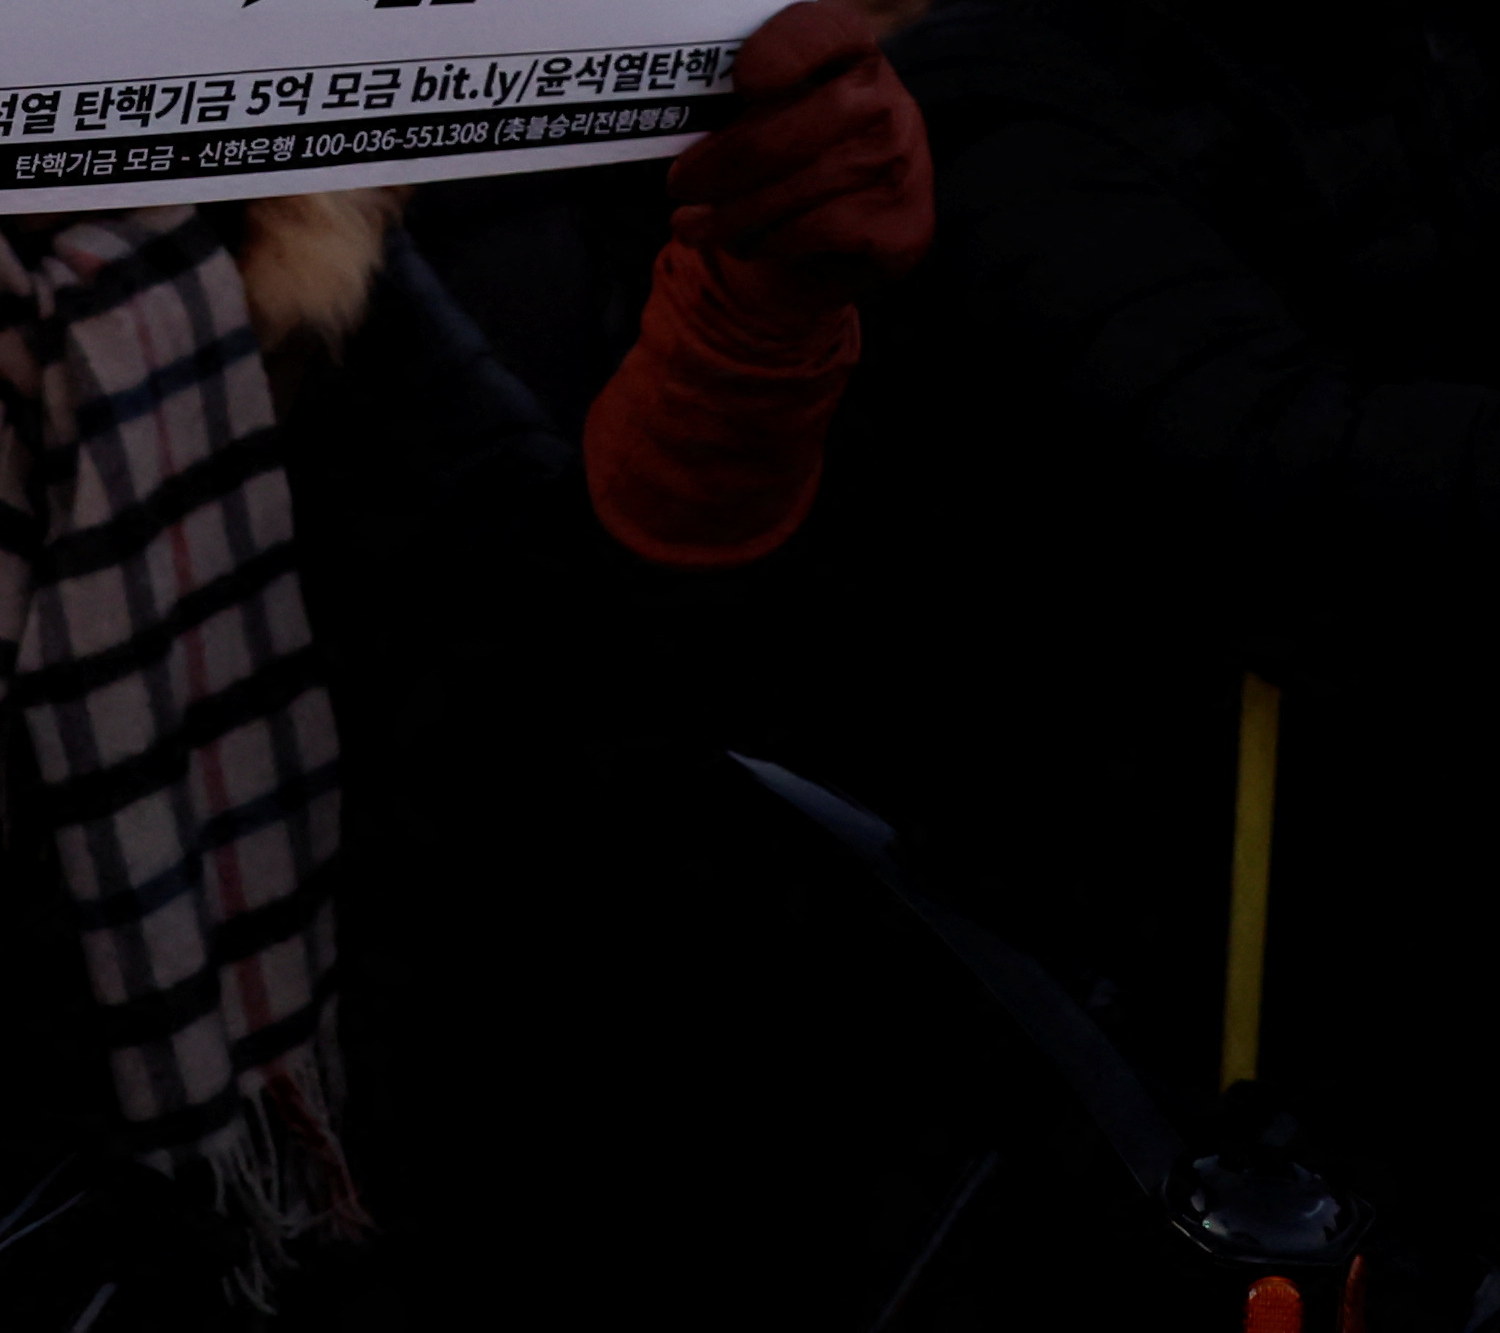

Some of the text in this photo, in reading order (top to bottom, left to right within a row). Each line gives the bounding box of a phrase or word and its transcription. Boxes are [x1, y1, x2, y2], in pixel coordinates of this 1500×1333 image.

[75, 81, 235, 131] 탄핵기금
[246, 73, 313, 114] 5억
[322, 69, 400, 109] 모금
[16, 150, 117, 179] 탄핵기금
[123, 146, 174, 171] 모금
[198, 135, 296, 167] 신한은행
[301, 121, 489, 158] 100-036-551308
